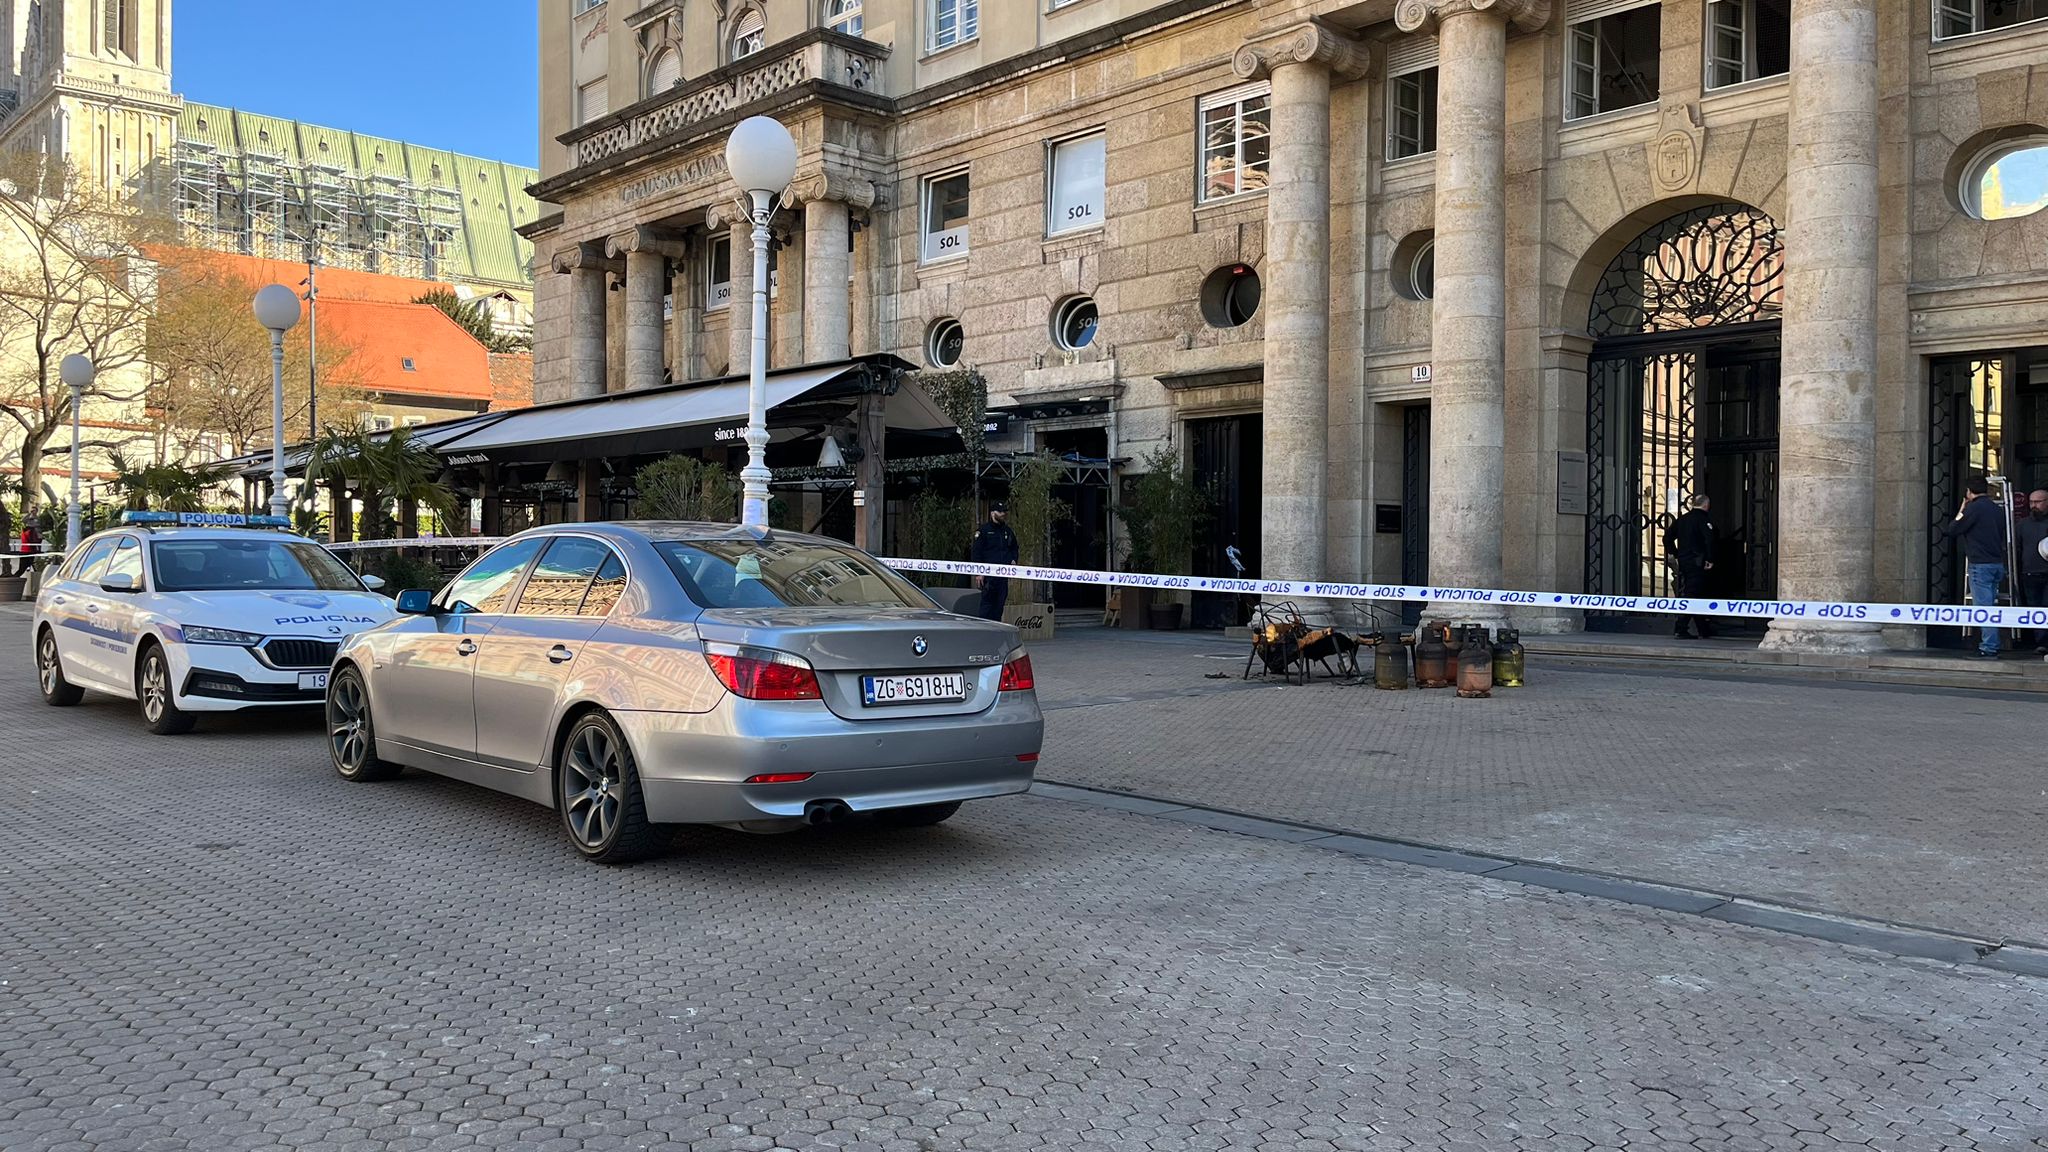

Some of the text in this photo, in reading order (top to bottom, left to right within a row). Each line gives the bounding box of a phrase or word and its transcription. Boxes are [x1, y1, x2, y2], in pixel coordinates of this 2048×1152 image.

[681, 153, 728, 183] KAVAN
[1068, 203, 1092, 220] SOL
[940, 234, 960, 249] SOL
[664, 301, 673, 310] OL
[948, 338, 961, 349] SO
[1416, 366, 1427, 377] 10
[714, 426, 748, 441] since 189
[184, 513, 243, 524] POLICIJA
[918, 562, 938, 571] STOP
[955, 563, 991, 575] POLICIJA
[996, 567, 1017, 576] STOP
[1035, 568, 1073, 580] POLICIJA
[1077, 571, 1100, 582] STOP
[1119, 574, 1159, 586] POLICIJA
[1164, 578, 1189, 588] STOP
[1210, 579, 1256, 591] POLICIJA
[1262, 583, 1290, 593] STOP
[1316, 584, 1367, 596] POLICIJA
[1373, 587, 1405, 598] STOP
[1434, 589, 1492, 601] POLICIJA
[1500, 592, 1537, 603] STOP
[1569, 595, 1637, 609] POLICIJA
[1647, 598, 1688, 610] STOP
[1727, 600, 1806, 616] POLICIJA
[1818, 604, 1867, 618] STOP
[1911, 606, 2002, 623] POLICIJA
[274, 615, 377, 626] POLICIJA
[1014, 615, 1044, 629] Coca-Cola
[2018, 610, 2048, 625] OP
[876, 679, 895, 699] ZG
